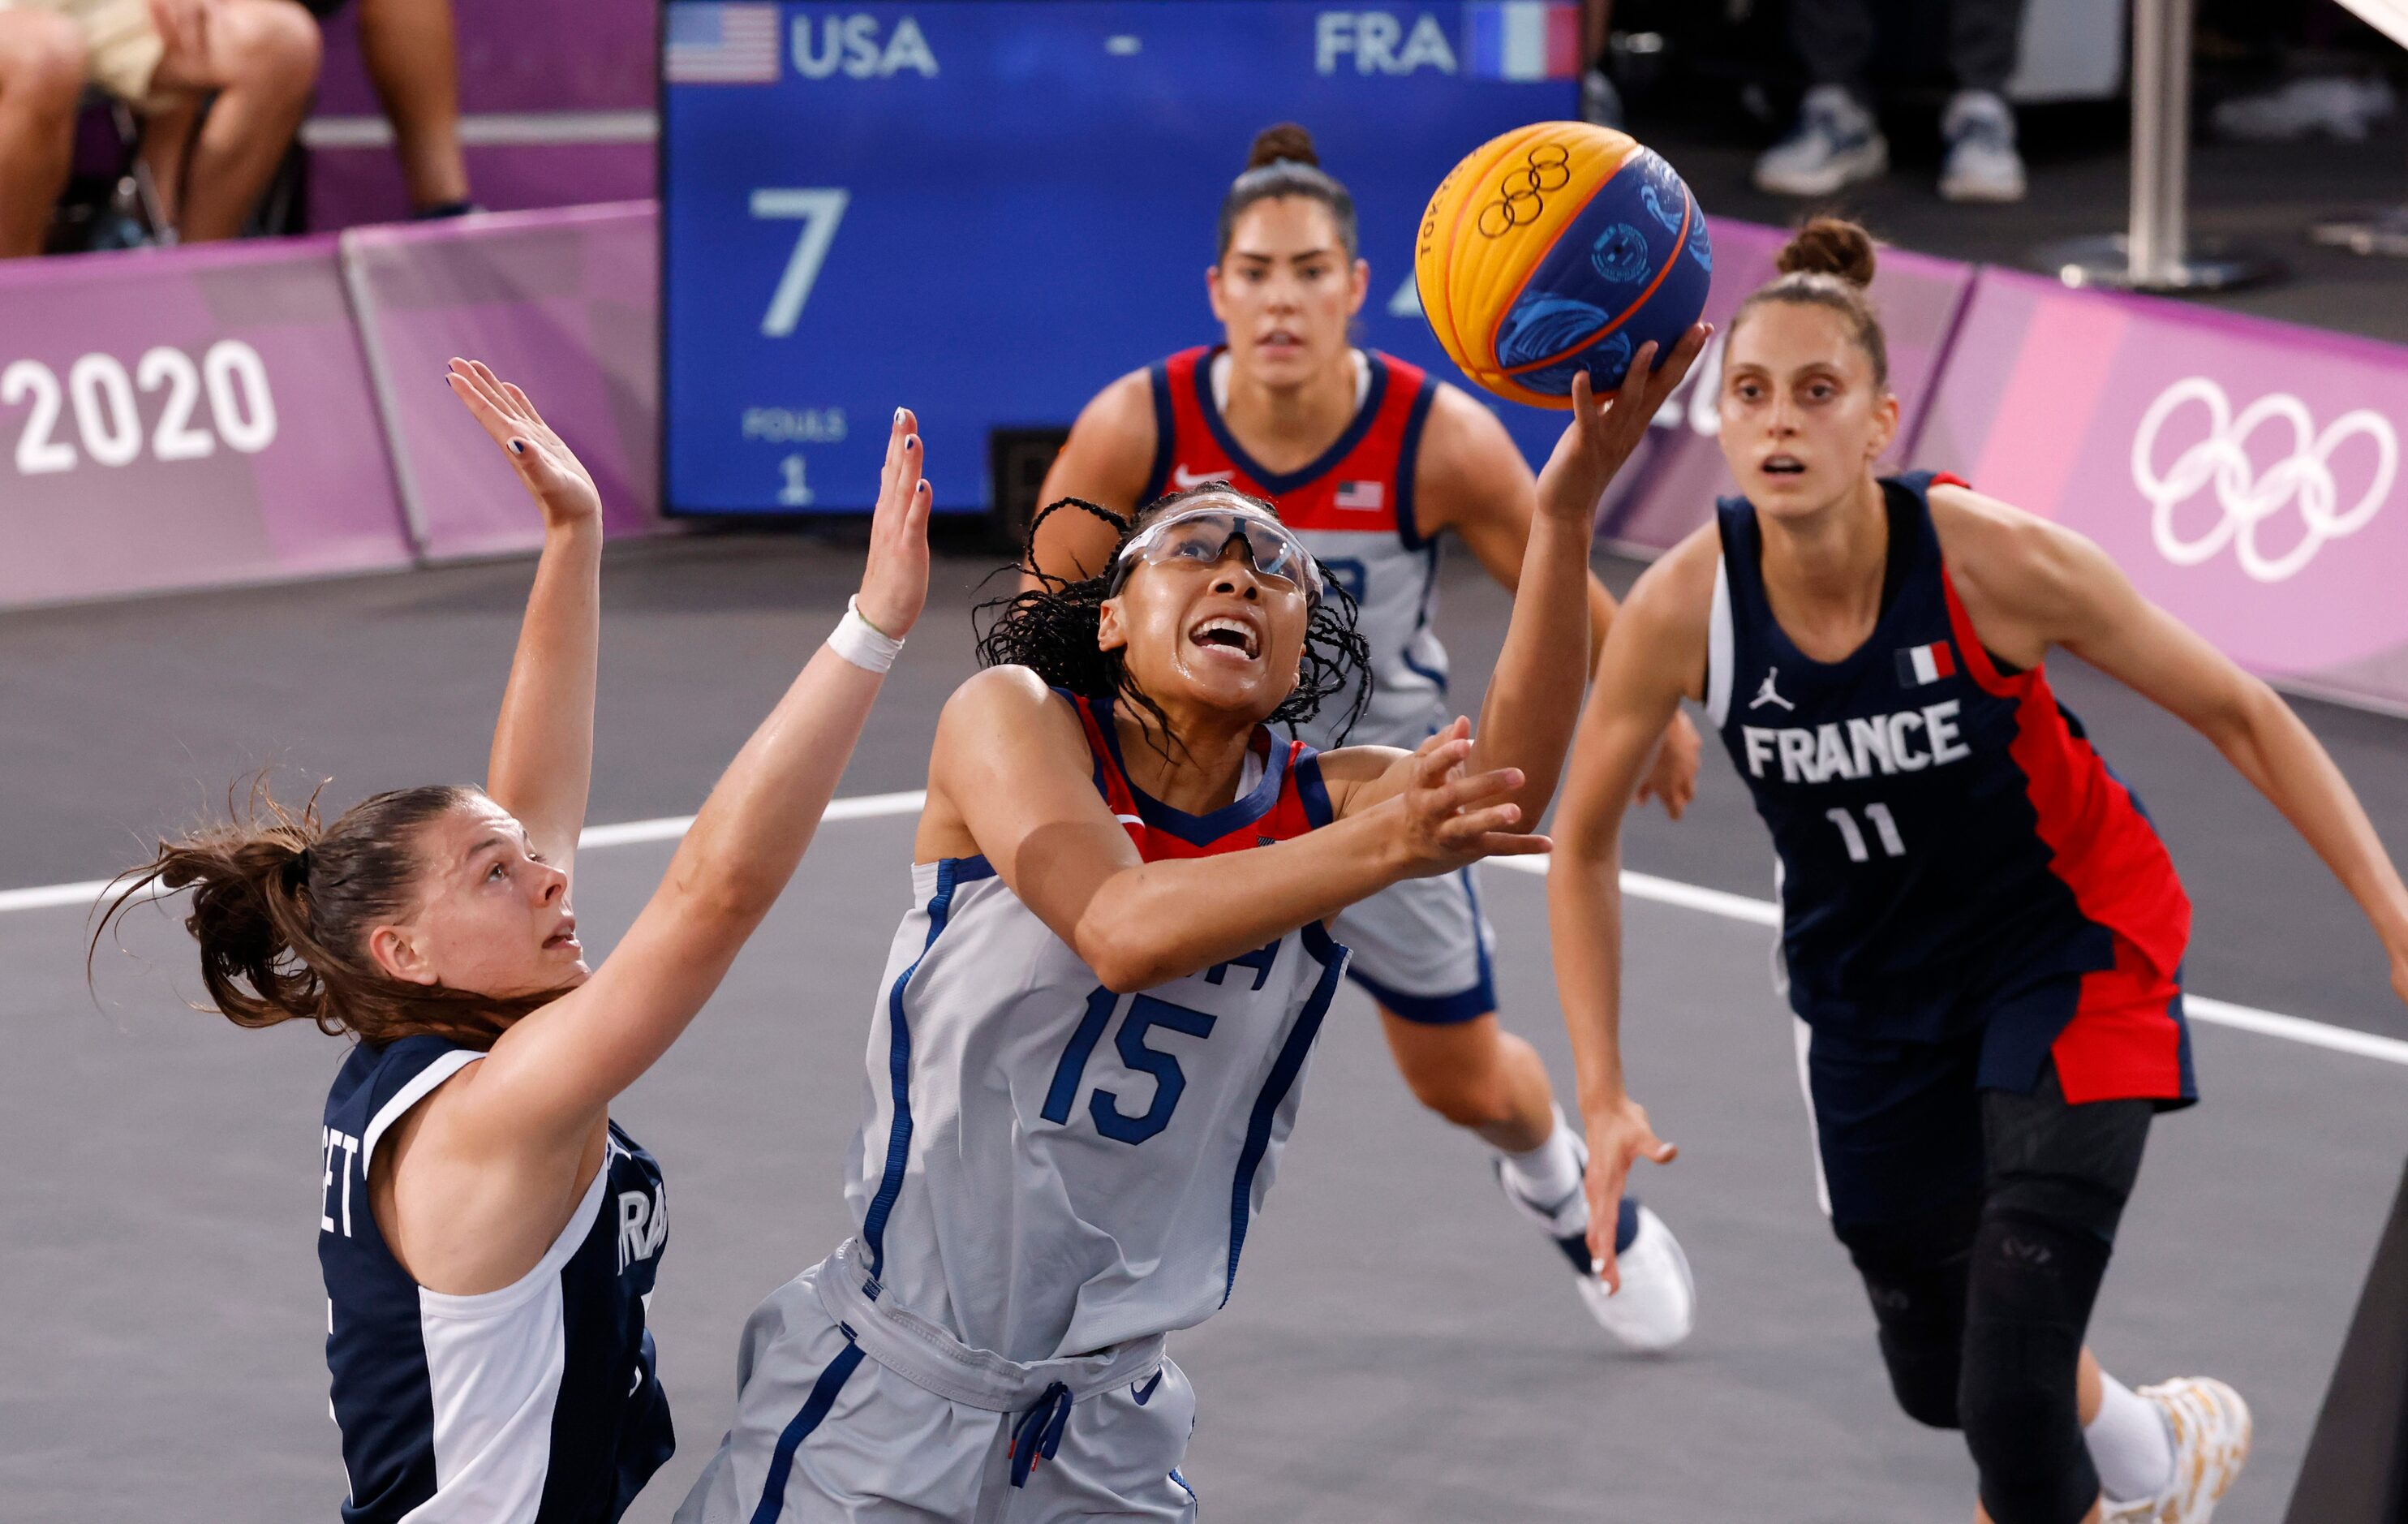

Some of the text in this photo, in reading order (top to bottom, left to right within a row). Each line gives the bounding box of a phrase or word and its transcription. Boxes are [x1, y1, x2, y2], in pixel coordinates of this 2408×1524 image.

[790, 13, 940, 79] USA
[1315, 11, 1457, 76] FRA
[750, 187, 850, 338] 7
[0, 339, 277, 476] 2020
[742, 407, 848, 442] FOULS
[776, 454, 815, 506] 1
[1743, 699, 1972, 783] FRANCE
[1825, 802, 1907, 863] 11
[1040, 984, 1218, 1146] 15
